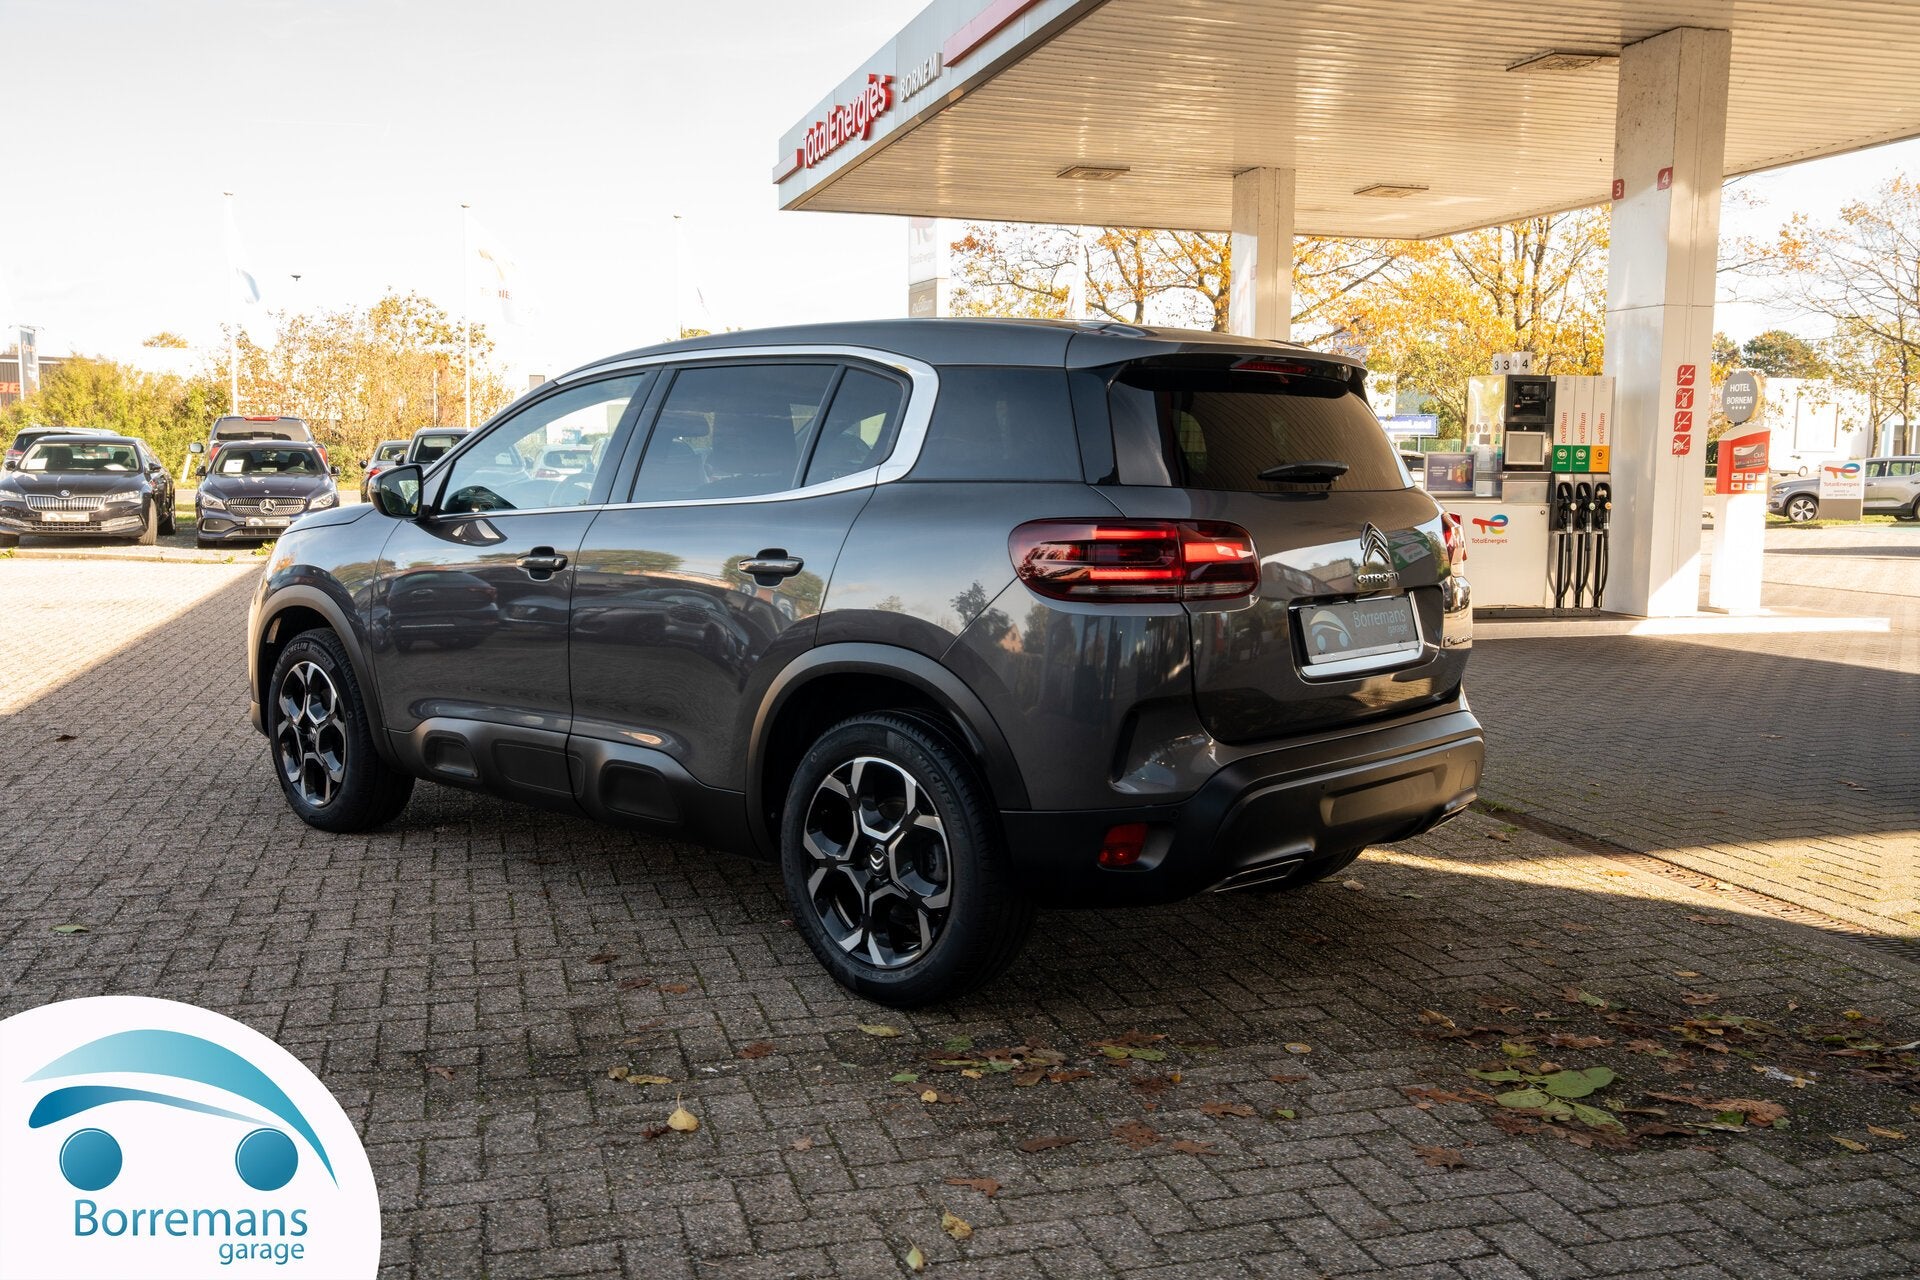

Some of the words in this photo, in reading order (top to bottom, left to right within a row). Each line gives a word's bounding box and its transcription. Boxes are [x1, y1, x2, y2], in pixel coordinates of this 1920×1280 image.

[899, 52, 943, 103] BORNEM
[803, 74, 895, 169] TotalEnergies
[1661, 171, 1670, 186] 4
[1615, 182, 1622, 197] 3
[1503, 360, 1510, 371] 3
[1522, 359, 1529, 369] 4
[1729, 383, 1750, 393] HOTEL
[1726, 396, 1753, 406] BORNEM
[1471, 537, 1508, 545] TotalEnergies
[1352, 608, 1407, 629] Borremans
